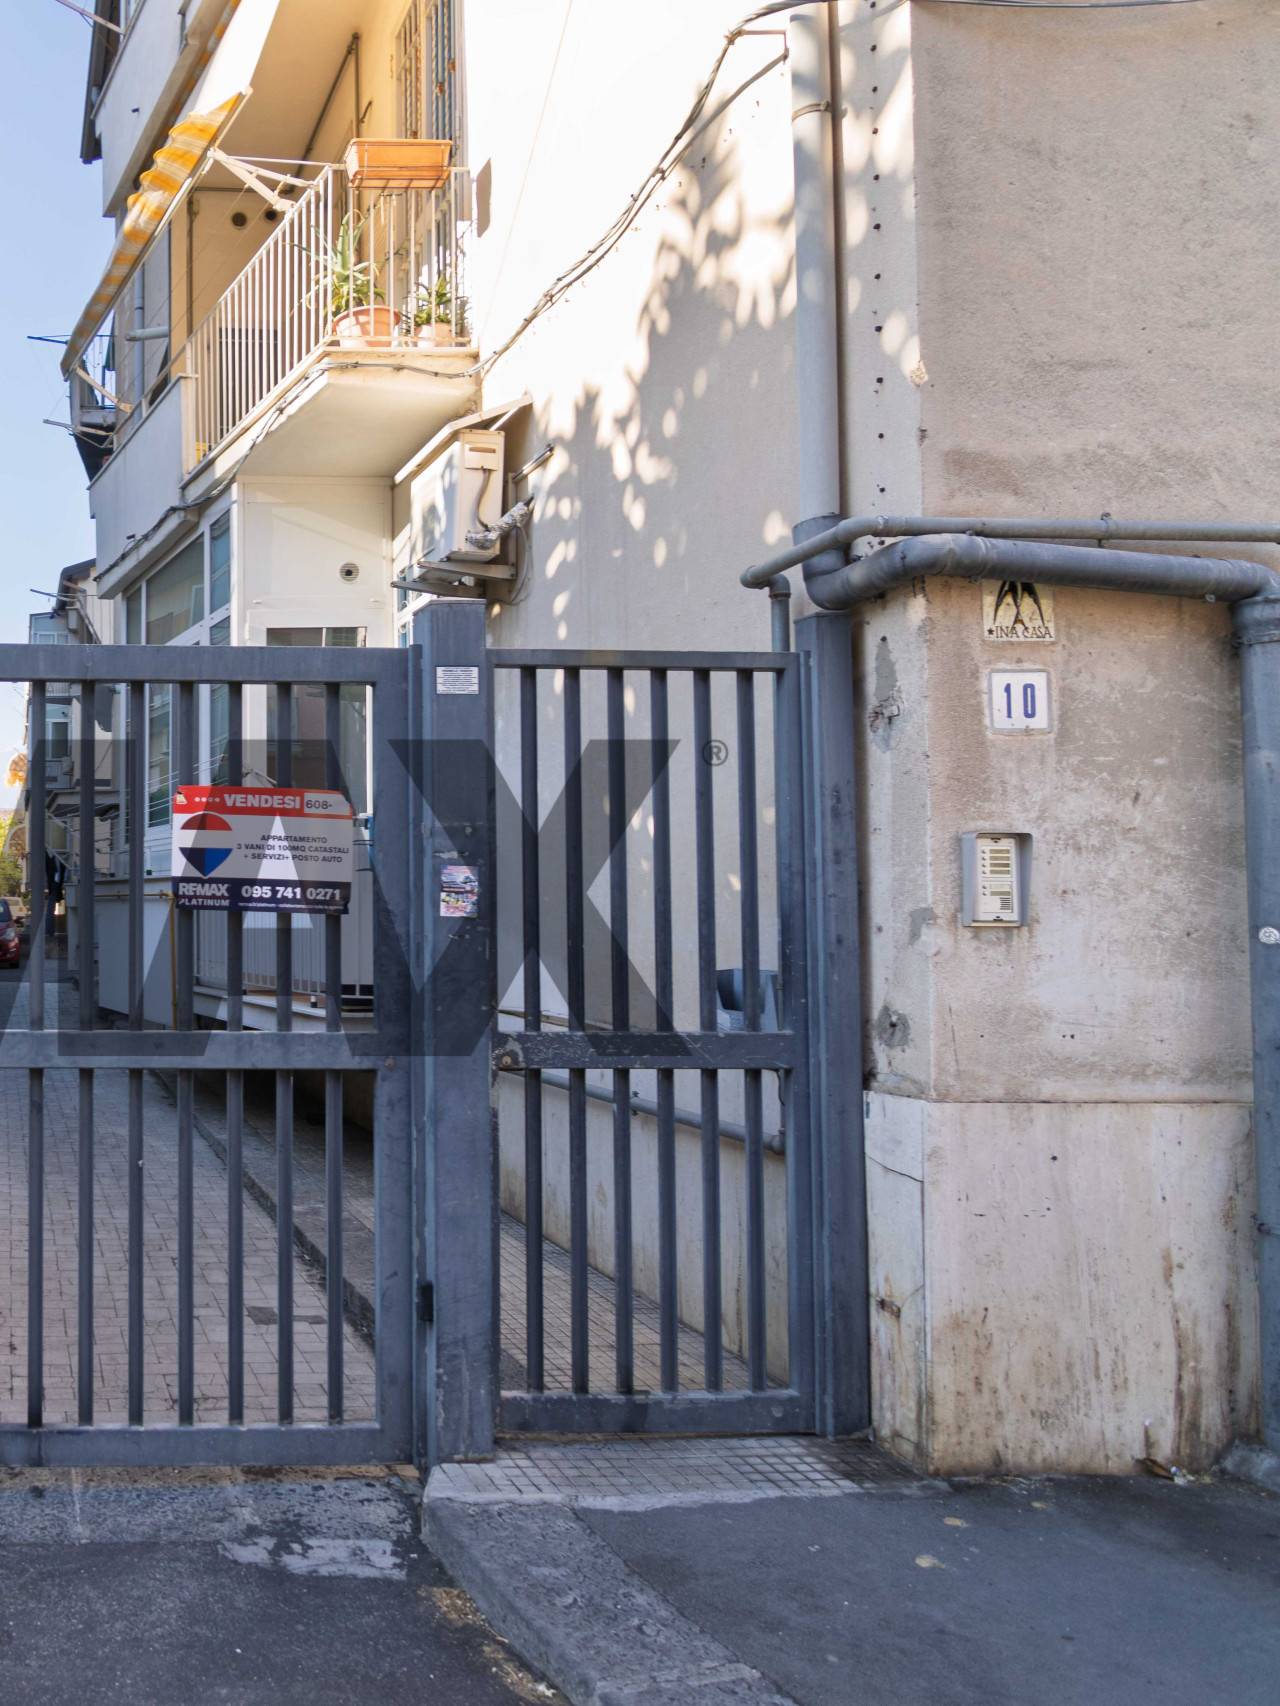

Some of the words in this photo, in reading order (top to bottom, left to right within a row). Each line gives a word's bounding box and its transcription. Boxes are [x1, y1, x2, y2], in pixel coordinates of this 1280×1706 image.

[995, 625, 1019, 639] INA
[1023, 625, 1053, 639] CASA
[1003, 682, 1037, 719] 10
[224, 793, 301, 809] VENDESI
[260, 834, 328, 844] APPARTAMENTO
[308, 845, 350, 854] CATASTALI
[292, 854, 320, 862] POSTO
[321, 855, 343, 863] AUTO
[241, 885, 272, 899] 095
[275, 886, 302, 900] 741
[306, 887, 341, 901] 0271
